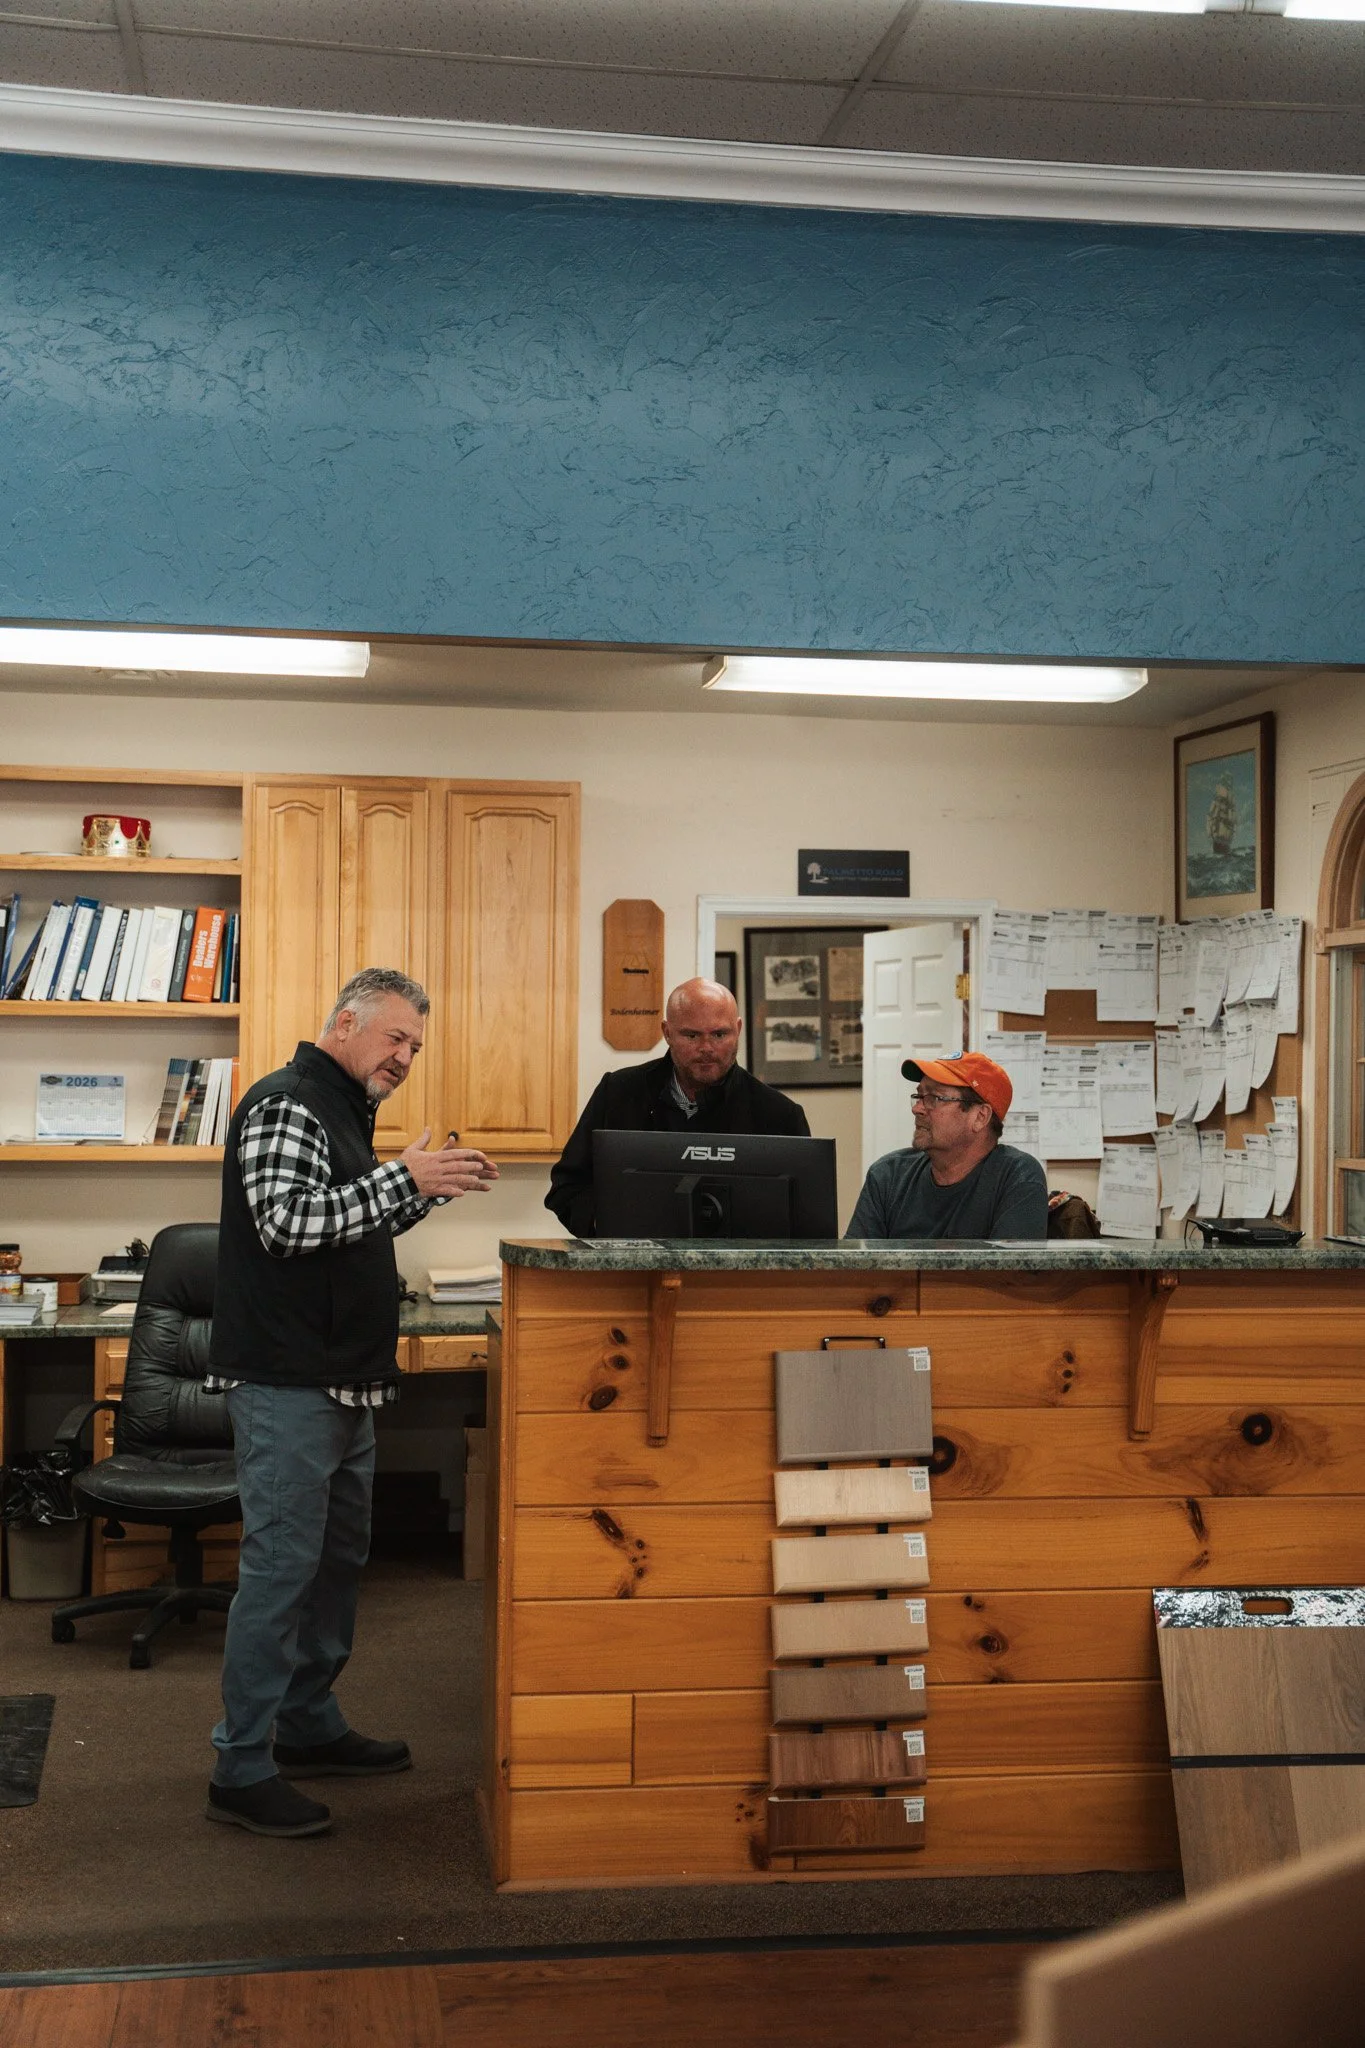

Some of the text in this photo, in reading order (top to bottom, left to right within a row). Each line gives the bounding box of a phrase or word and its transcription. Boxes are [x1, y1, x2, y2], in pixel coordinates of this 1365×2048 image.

[192, 930, 208, 967] Dealers
[203, 914, 222, 969] Warehouse
[66, 1076, 98, 1087] 2026
[681, 1146, 736, 1162] ASUS
